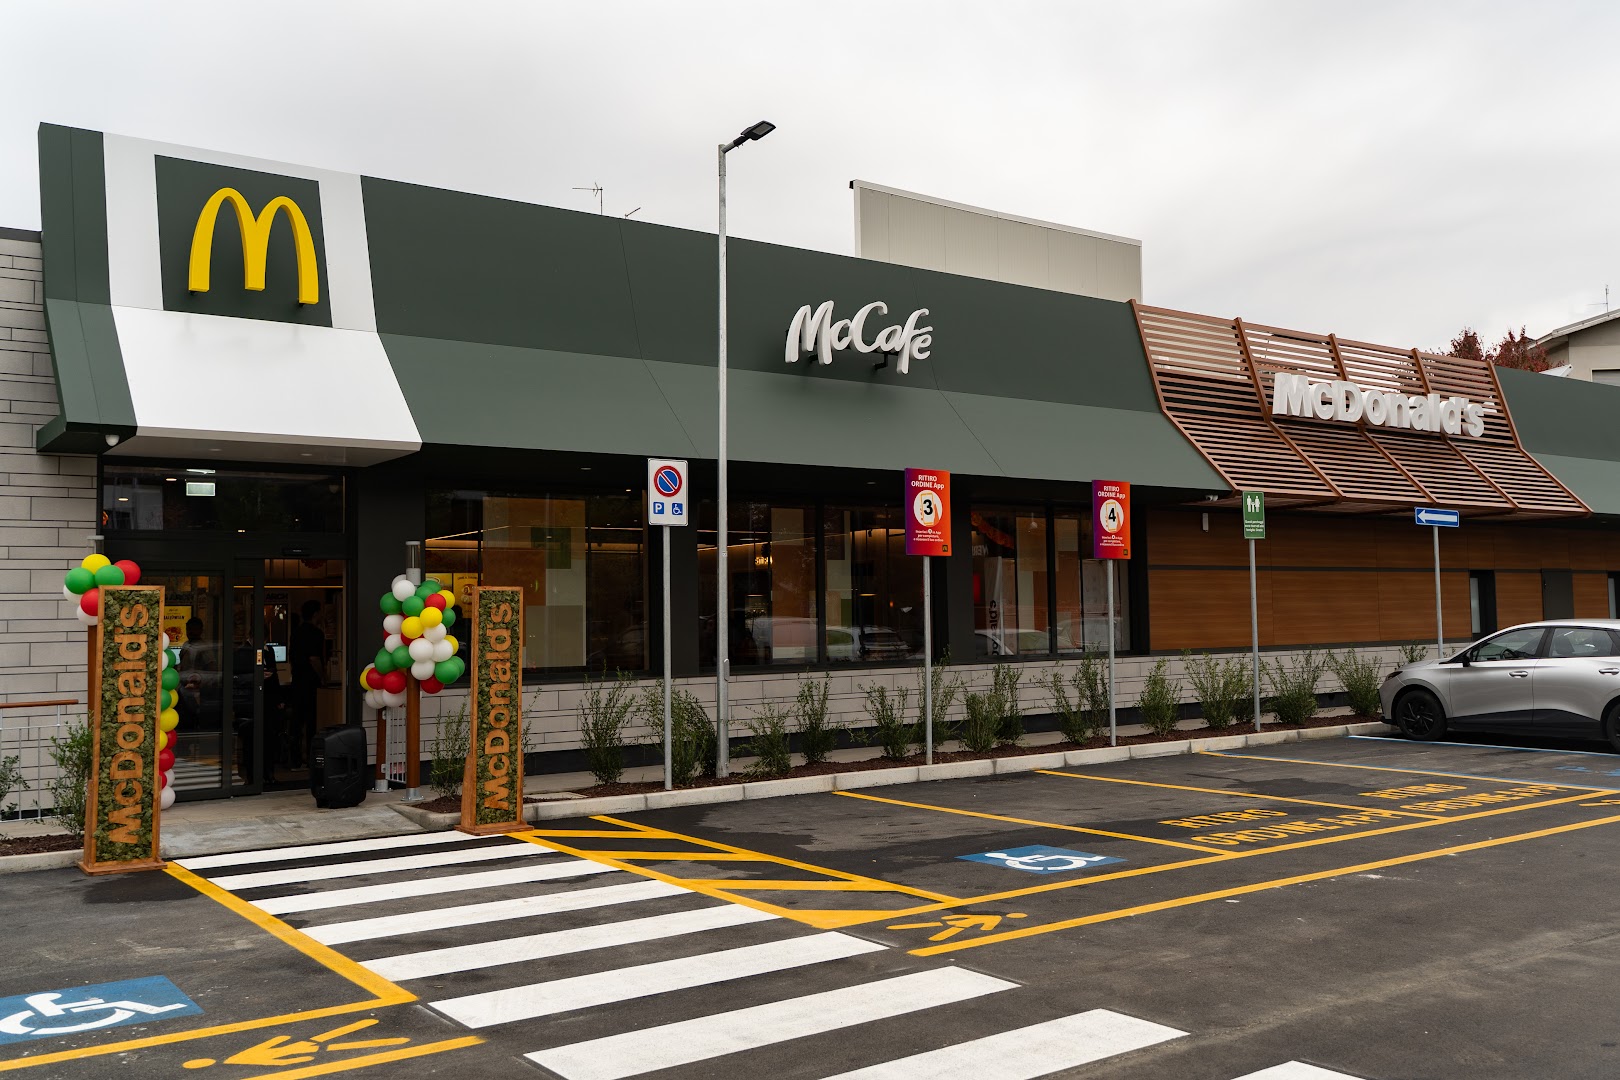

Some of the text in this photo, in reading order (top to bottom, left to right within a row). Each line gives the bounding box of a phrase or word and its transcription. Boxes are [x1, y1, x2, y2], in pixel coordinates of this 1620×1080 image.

[785, 300, 933, 375] McCafé
[1272, 372, 1485, 437] McDonald's
[911, 480, 945, 490] ORDINE App
[917, 474, 938, 482] RITIRO
[1116, 492, 1126, 500] App
[655, 503, 663, 513] P
[923, 499, 934, 516] 3
[1108, 507, 1117, 522] 4
[484, 601, 513, 811] McDonald's
[107, 602, 149, 844] McDonald's
[1358, 783, 1467, 799] RITIRO
[1400, 793, 1525, 812] ORDINE
[1157, 809, 1288, 828] RITIRO
[1190, 811, 1402, 845] ORDINE APP
